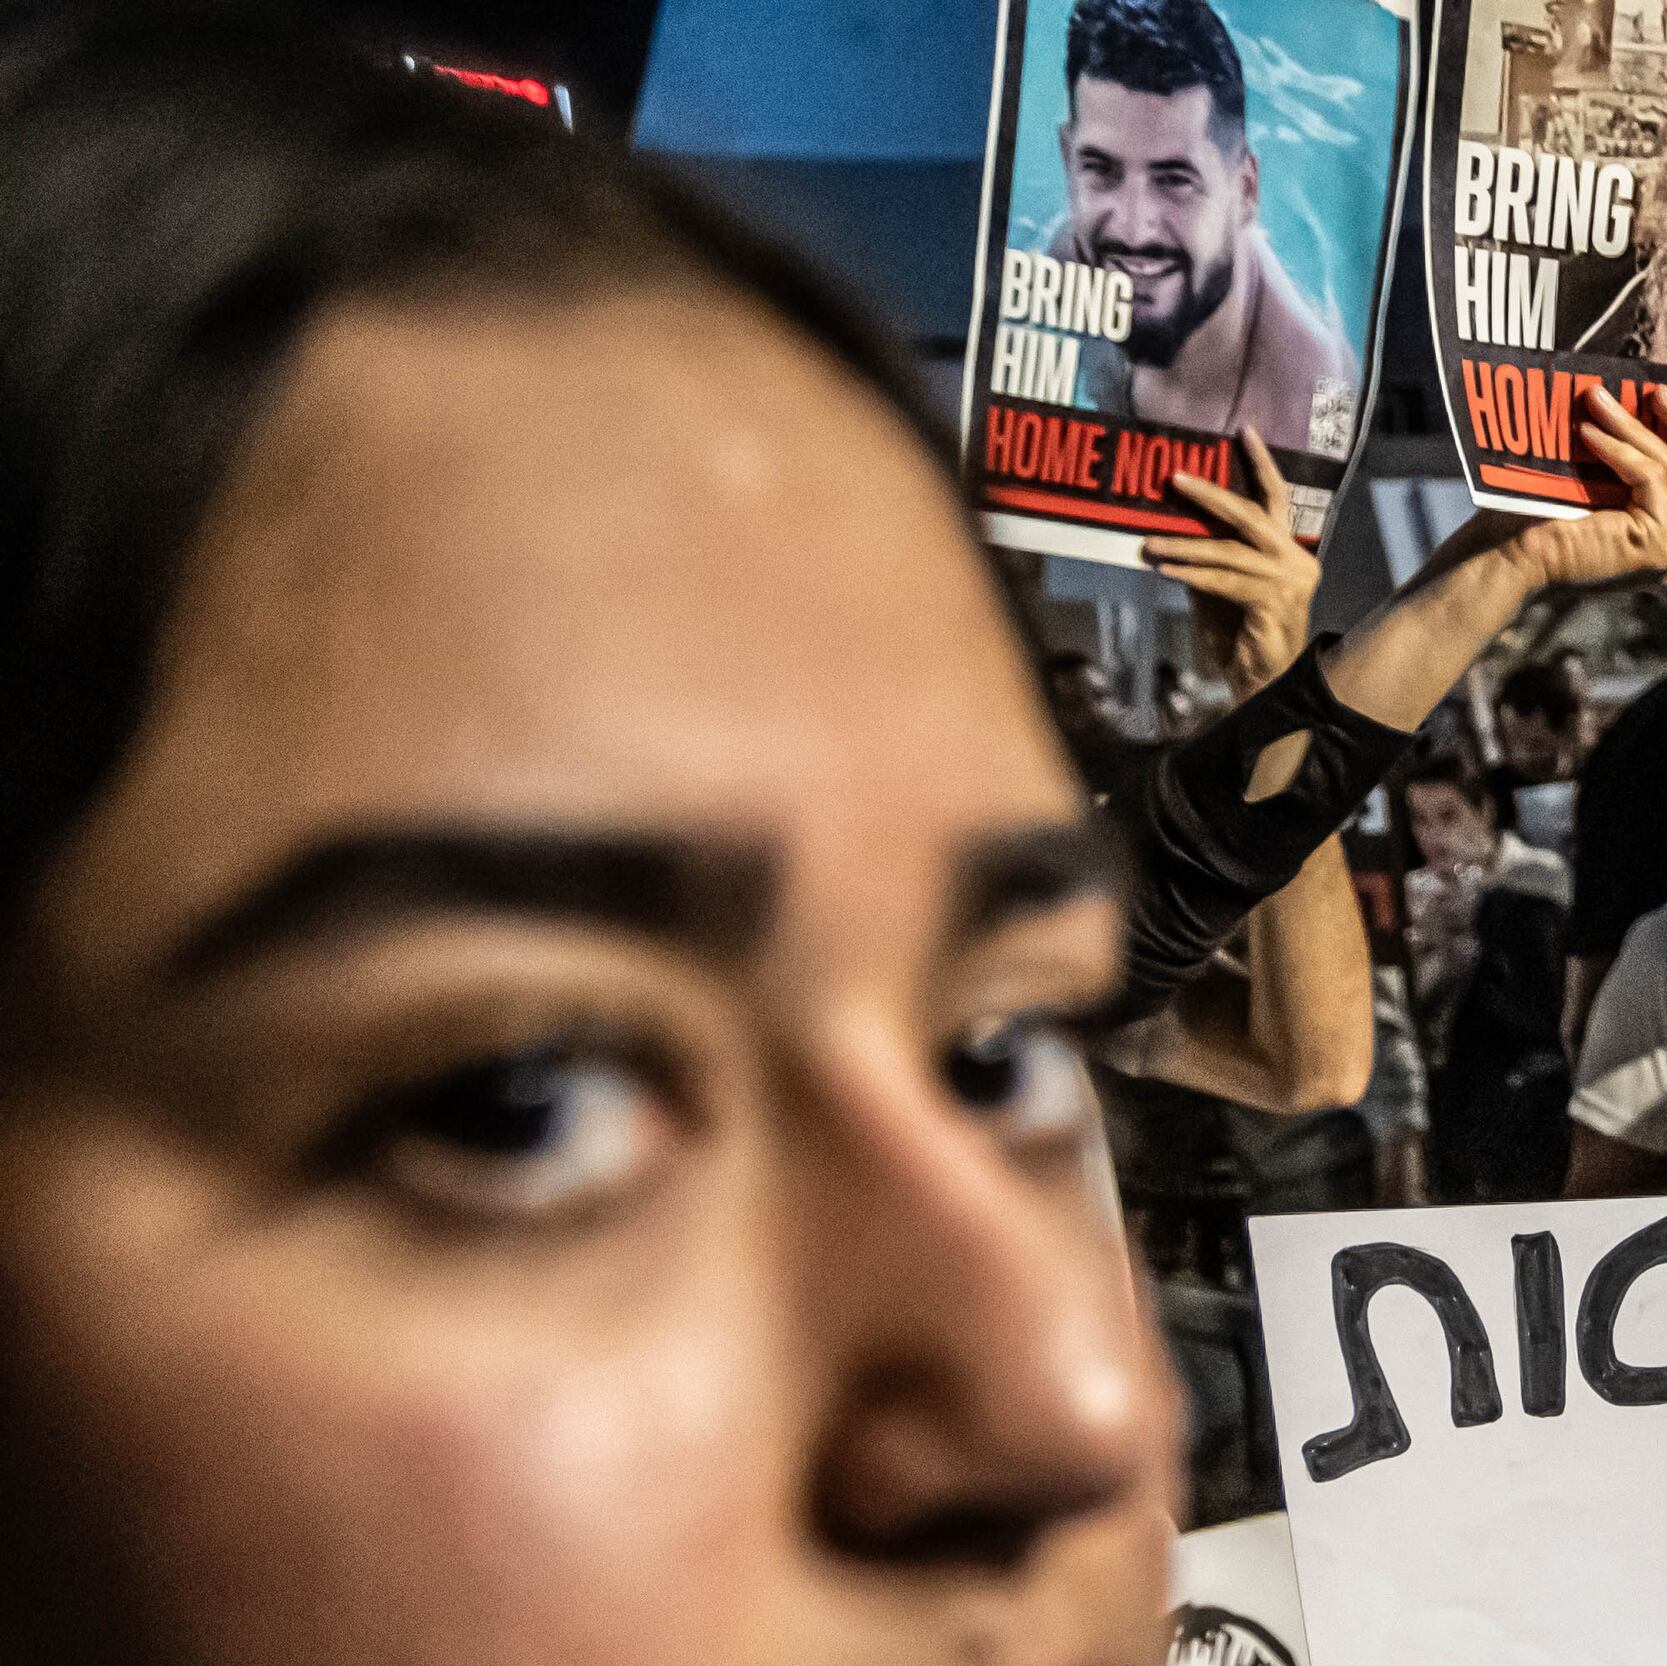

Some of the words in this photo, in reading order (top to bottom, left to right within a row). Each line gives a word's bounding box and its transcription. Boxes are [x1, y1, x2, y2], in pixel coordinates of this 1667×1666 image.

[1454, 140, 1635, 259] BRING
[1002, 248, 1135, 344] BRING
[1454, 244, 1561, 353] HIM
[989, 321, 1080, 407] HIM
[985, 405, 1107, 490] HOME
